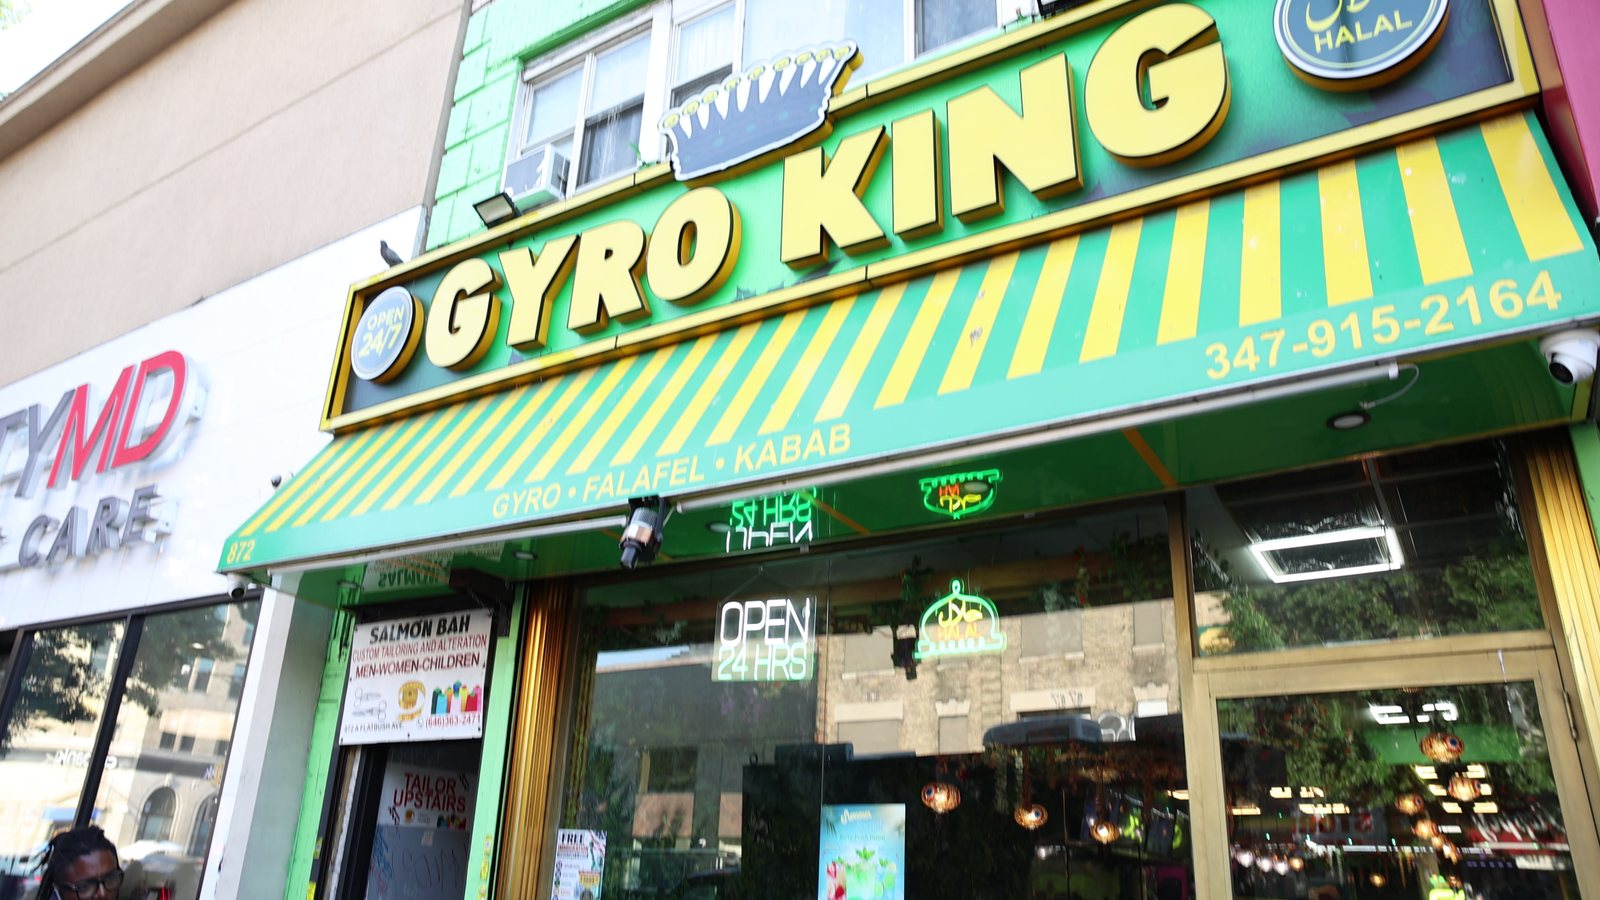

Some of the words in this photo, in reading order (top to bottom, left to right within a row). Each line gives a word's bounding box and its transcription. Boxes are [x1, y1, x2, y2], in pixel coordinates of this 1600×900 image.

[1313, 9, 1413, 54] HALAL
[425, 186, 737, 370] GYRO
[780, 2, 1229, 263] KING
[367, 303, 405, 331] OPEN
[1204, 269, 1563, 380] 347-915-2164
[358, 322, 403, 358] 24/7
[491, 482, 562, 519] GYRO
[583, 456, 705, 503] FALAFEL
[734, 423, 852, 474] KABAB
[18, 484, 158, 568] CARE
[226, 540, 256, 564] 872
[369, 620, 433, 645] SALMON
[436, 613, 471, 636] BAH
[720, 597, 811, 647] OPEN
[352, 645, 380, 662] CUSTOM
[381, 640, 419, 659] TAILORING
[420, 637, 437, 653] AND
[438, 633, 488, 652] ALTERATION
[718, 644, 749, 681] 24
[754, 642, 807, 681] HRS
[355, 652, 481, 679] MEN-WOMEN-CHILDREN
[393, 788, 466, 813] UPSTAIRS
[404, 772, 457, 795] TAILOR
[561, 832, 584, 845] FREE
